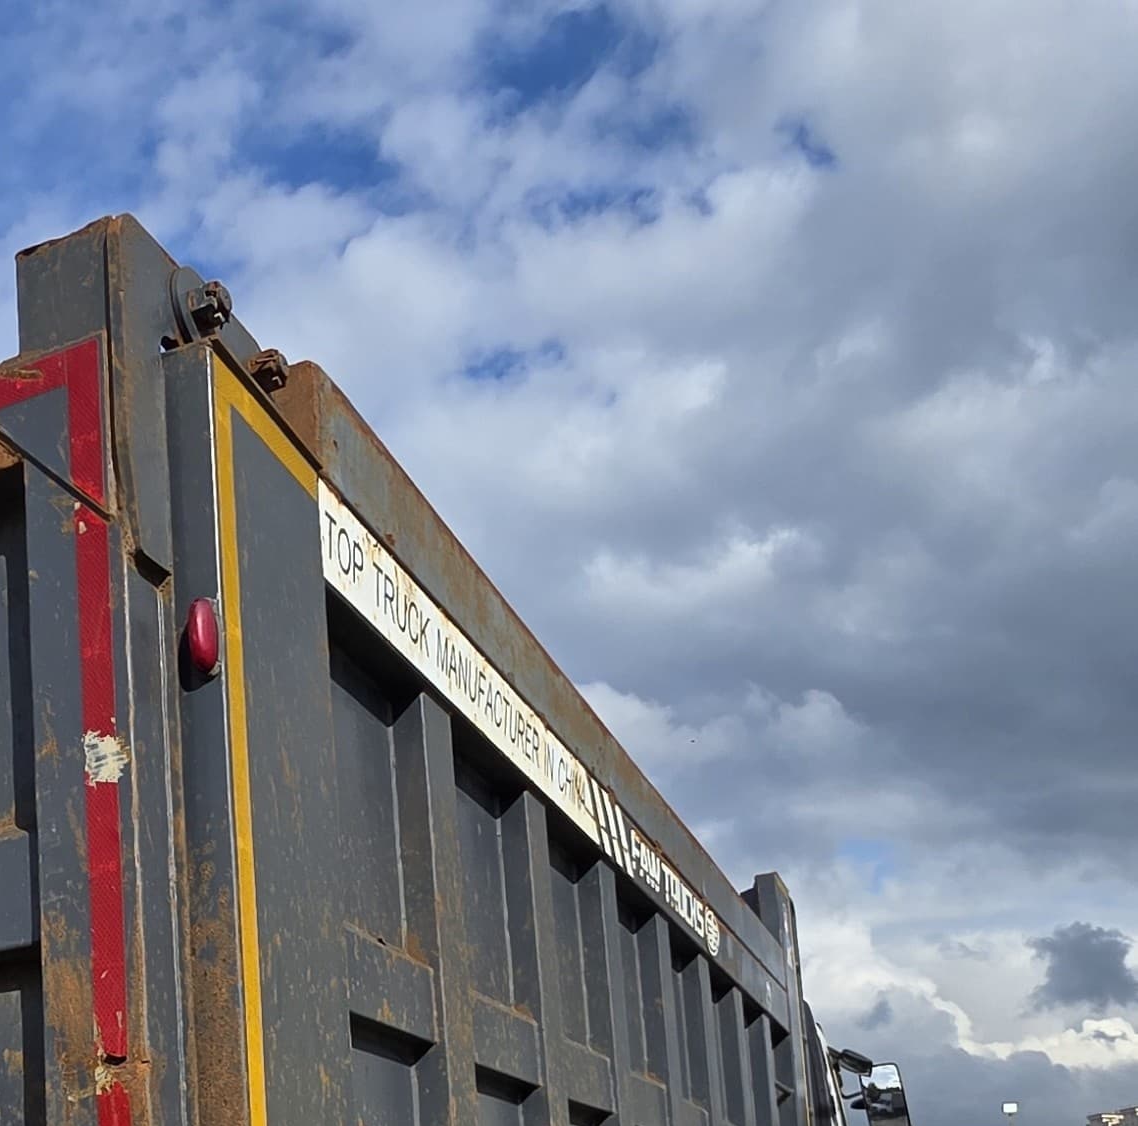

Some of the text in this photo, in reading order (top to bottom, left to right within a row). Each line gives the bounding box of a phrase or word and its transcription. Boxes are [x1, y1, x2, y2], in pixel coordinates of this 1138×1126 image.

[323, 509, 364, 586] TOP
[372, 560, 430, 658] TRUCK
[436, 628, 541, 765] MANUFACTURER
[543, 734, 555, 783] IN
[630, 828, 705, 938] FAW TRUCKS
